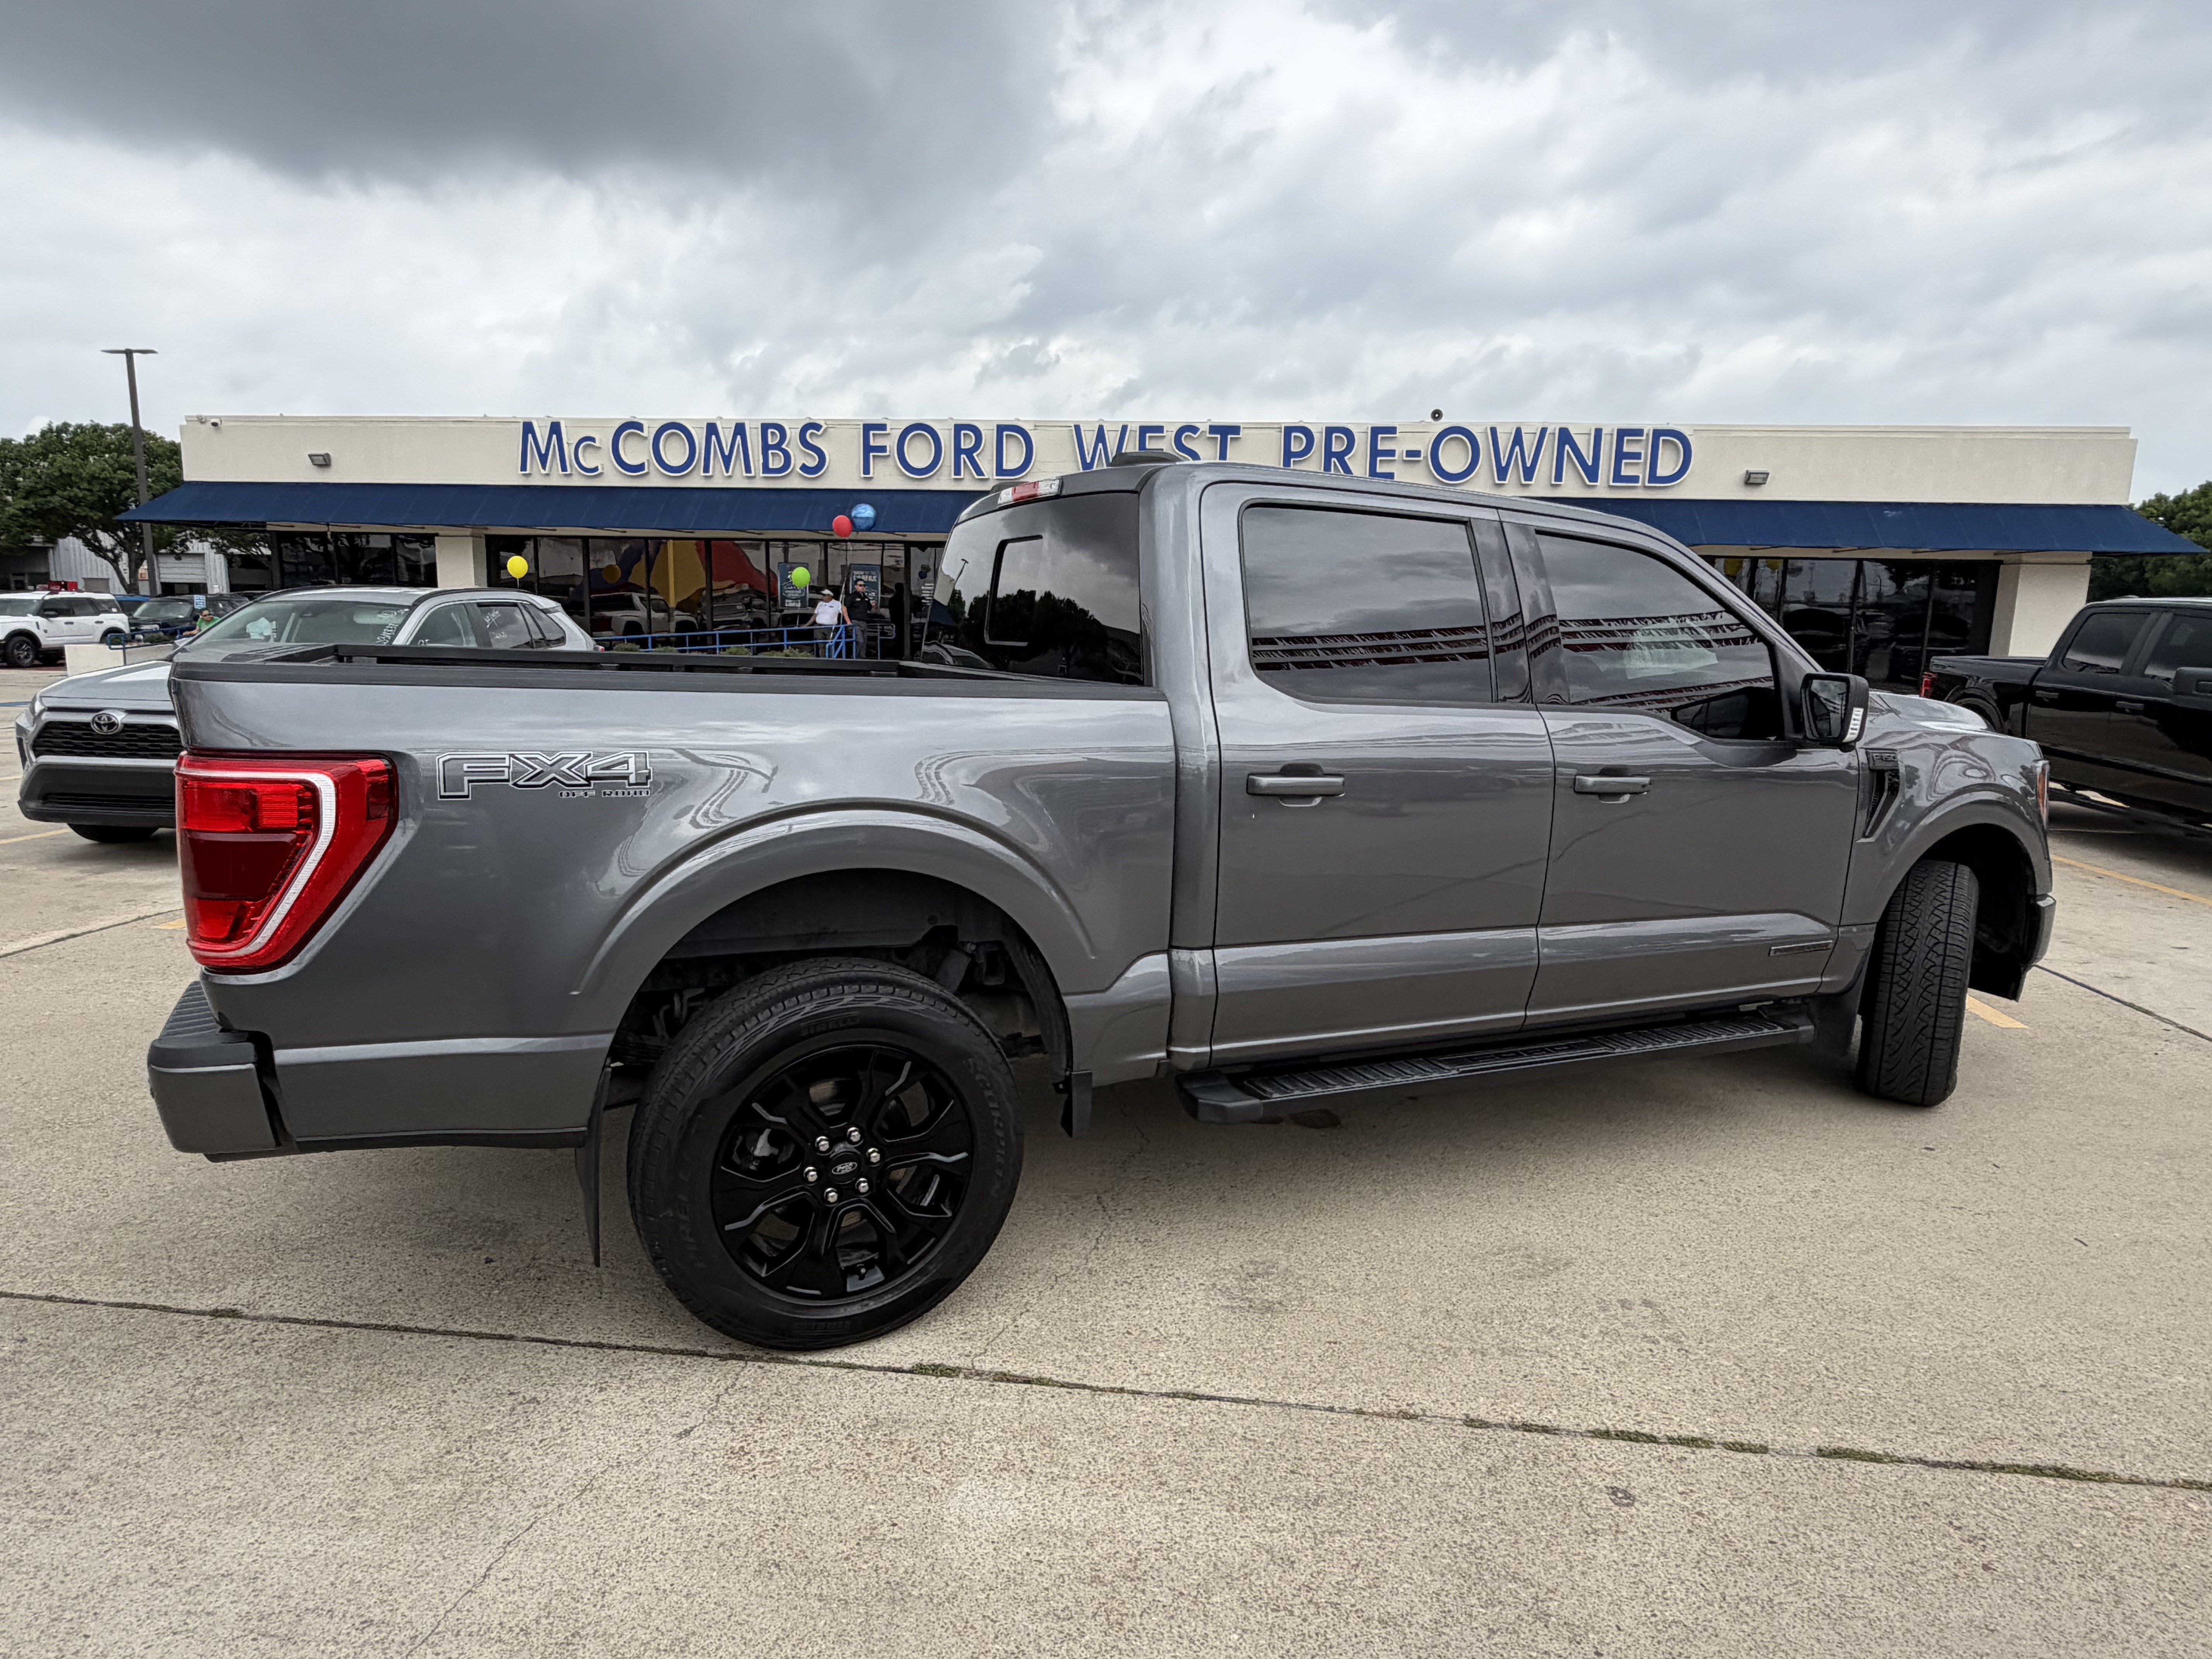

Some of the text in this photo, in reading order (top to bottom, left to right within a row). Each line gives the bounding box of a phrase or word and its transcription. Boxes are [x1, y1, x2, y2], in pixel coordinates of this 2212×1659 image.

[863, 423, 1034, 477] FORD
[1282, 426, 1692, 484] PRE-OWNED
[438, 751, 653, 800] FX4
[602, 789, 651, 797] ROAD
